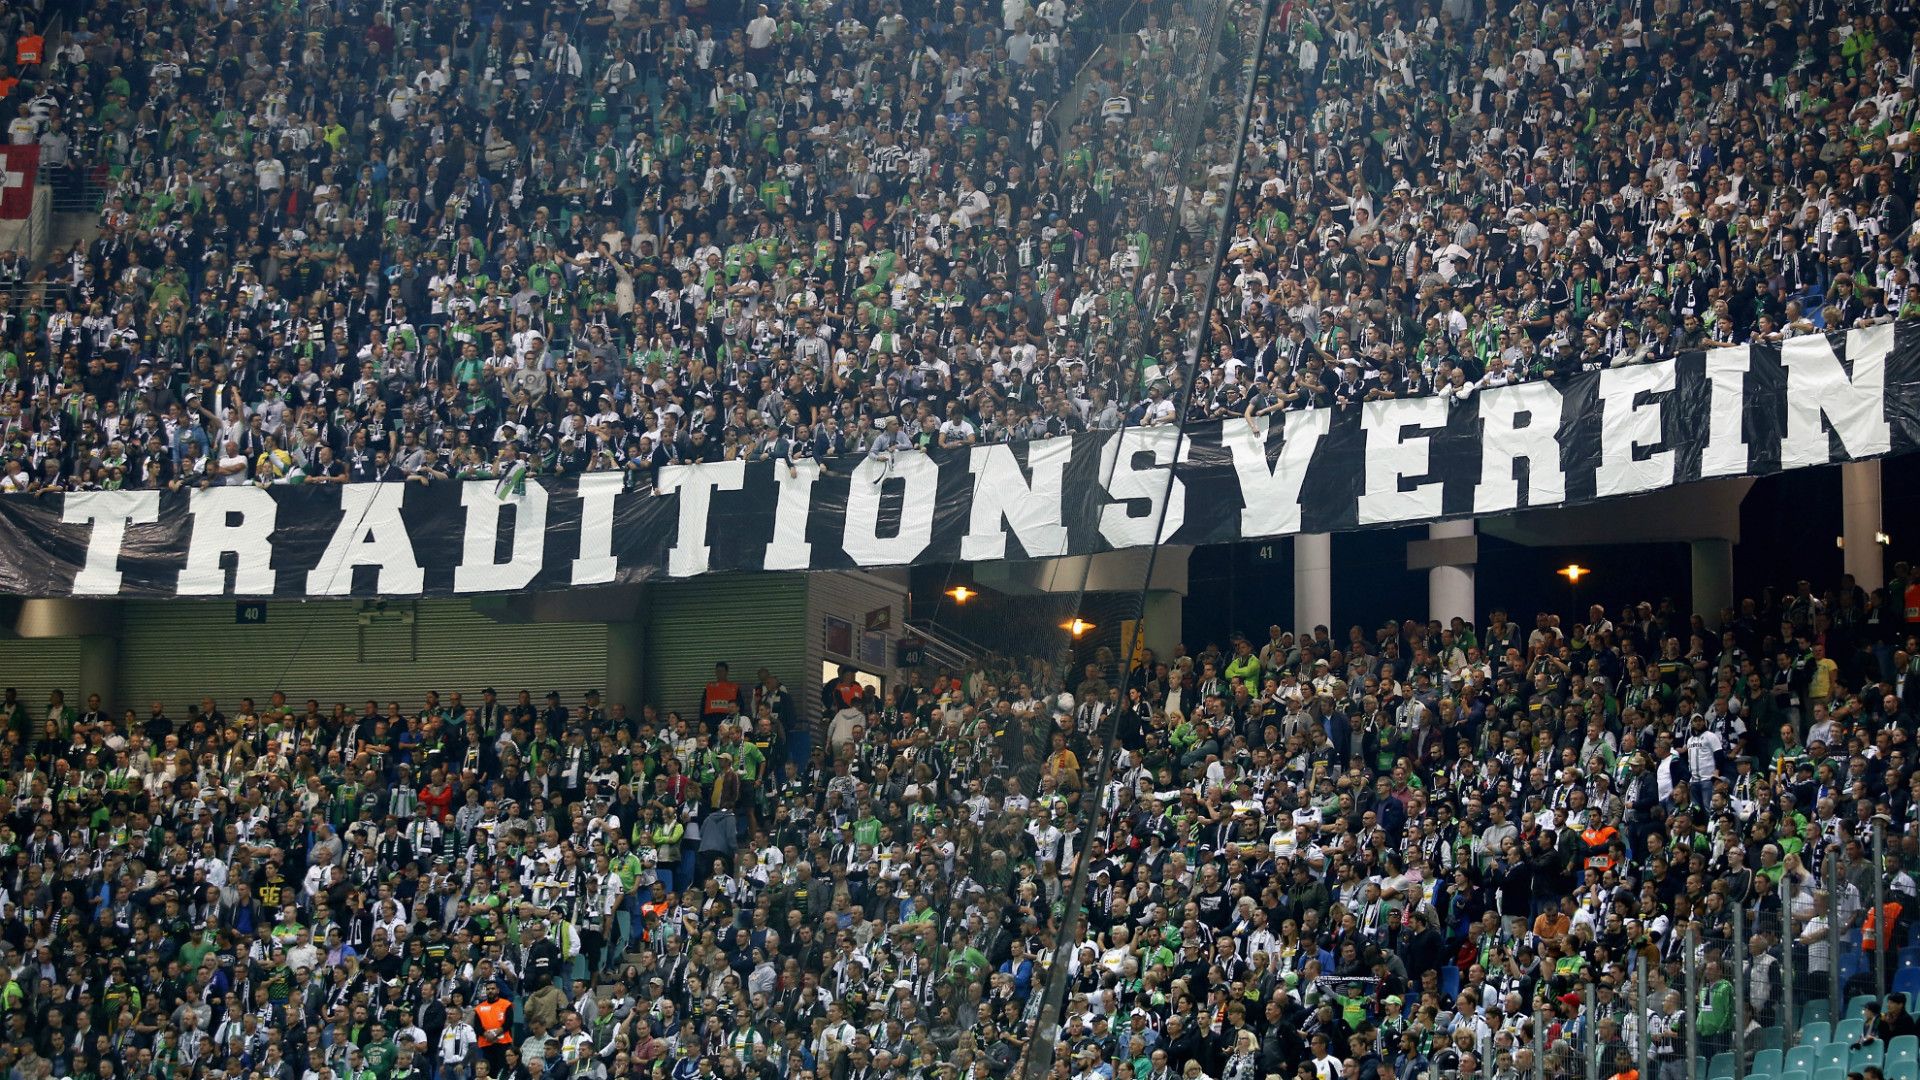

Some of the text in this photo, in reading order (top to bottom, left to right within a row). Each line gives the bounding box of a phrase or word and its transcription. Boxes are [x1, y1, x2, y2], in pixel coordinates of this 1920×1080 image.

[61, 323, 1896, 597] TRADITIONSVEREIN
[1260, 545, 1273, 559] 41
[245, 607, 259, 620] 40
[906, 652, 918, 663] 40
